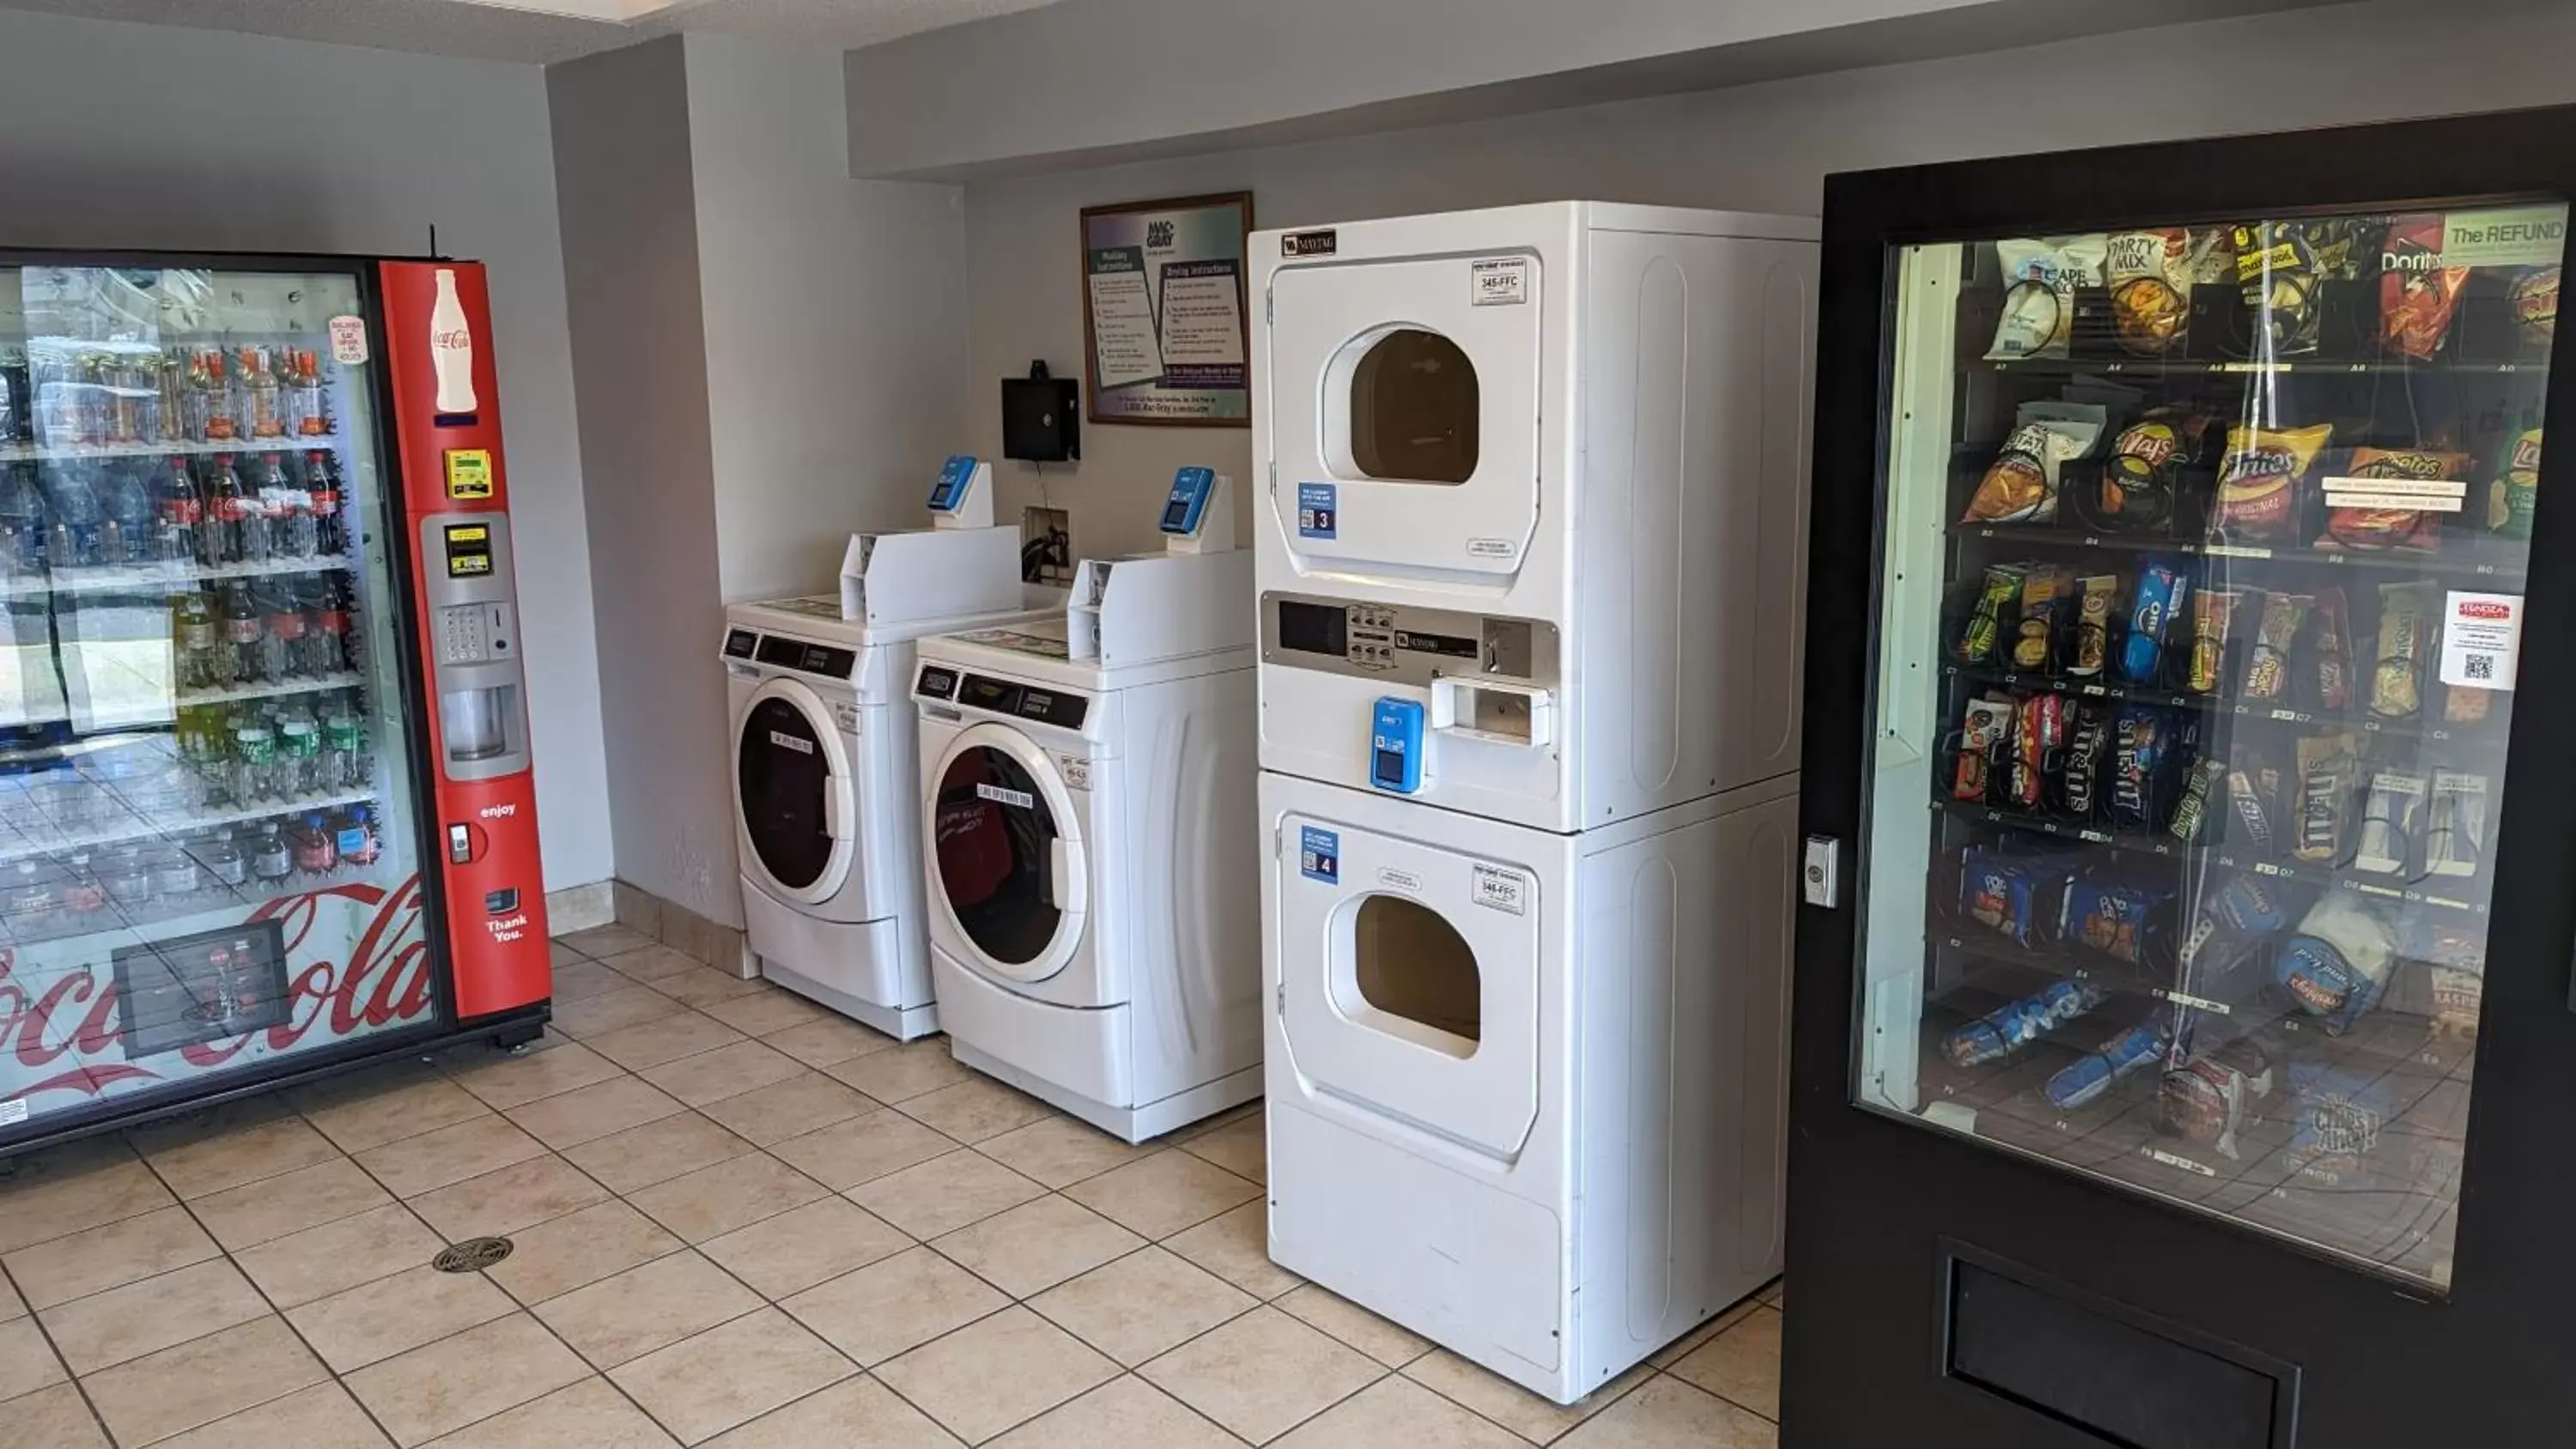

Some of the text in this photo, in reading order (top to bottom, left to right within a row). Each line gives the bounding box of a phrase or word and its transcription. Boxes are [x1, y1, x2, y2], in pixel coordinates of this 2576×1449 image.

[2453, 220, 2564, 245] The REFUND
[2110, 238, 2157, 256] PARTY
[2115, 256, 2148, 270] MIX
[2044, 269, 2087, 282] CAPE
[1320, 512, 1327, 528] 3
[480, 803, 516, 818] enjoy
[1321, 858, 1330, 873] 4
[485, 915, 527, 933] Thank
[494, 930, 523, 943] You.
